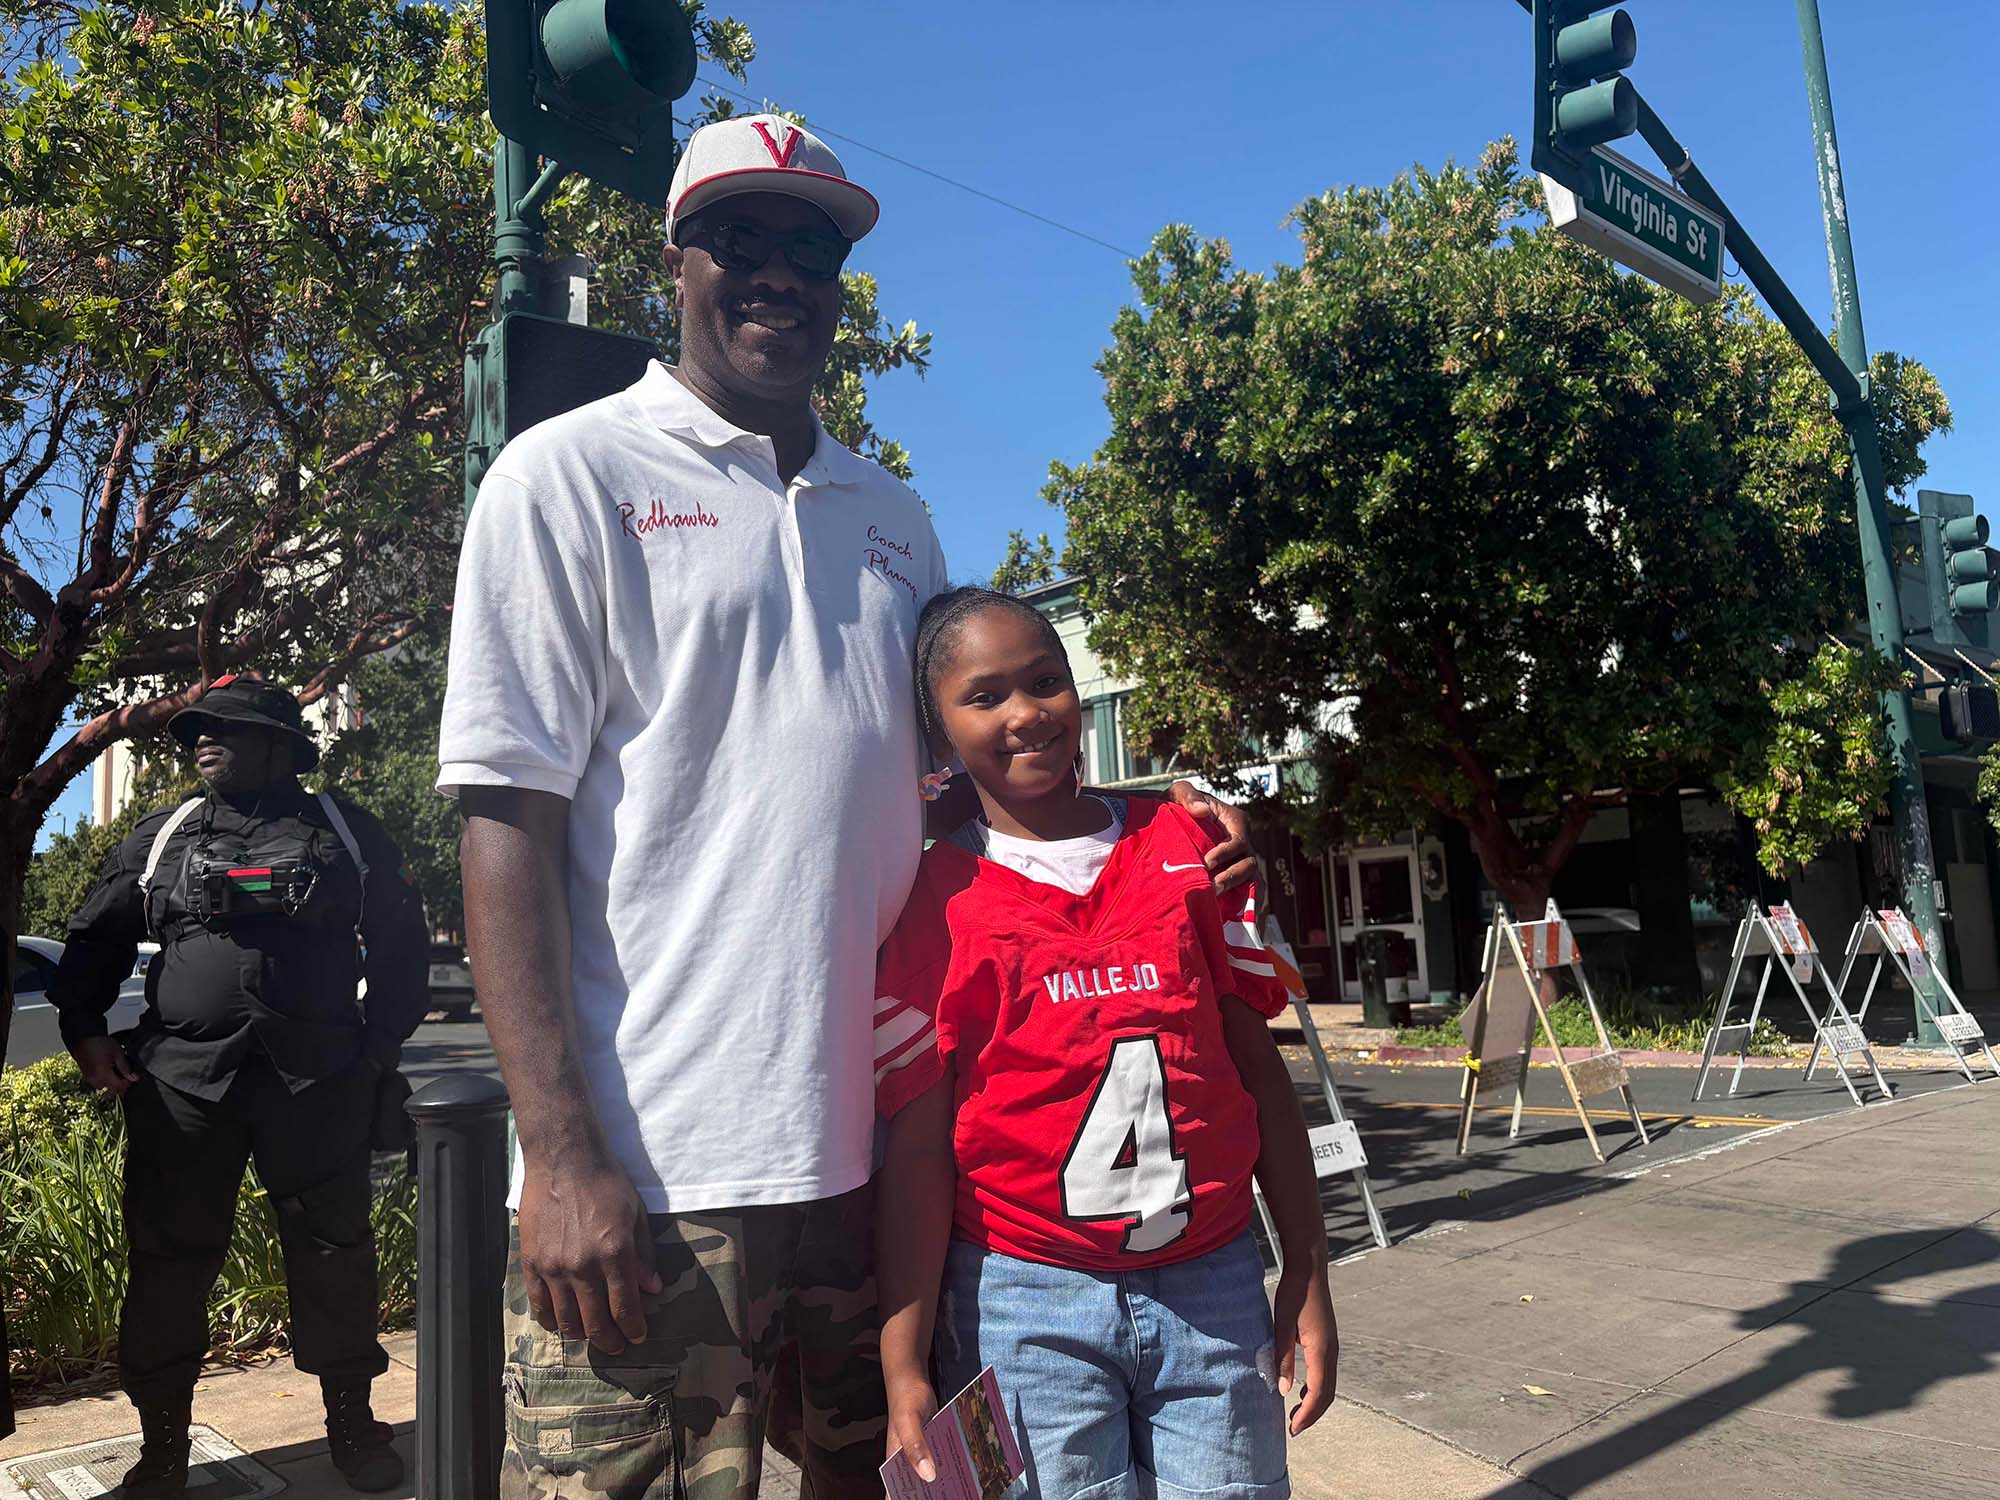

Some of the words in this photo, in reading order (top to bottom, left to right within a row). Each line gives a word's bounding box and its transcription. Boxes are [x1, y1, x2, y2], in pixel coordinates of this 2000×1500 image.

[750, 121, 803, 169] V
[1599, 165, 1678, 244] Virginia
[1686, 219, 1708, 261] St
[615, 499, 719, 542] Redhawks
[867, 525, 913, 561] Coach
[1043, 962, 1161, 1004] VALLEJO
[1057, 1033, 1195, 1255] 4
